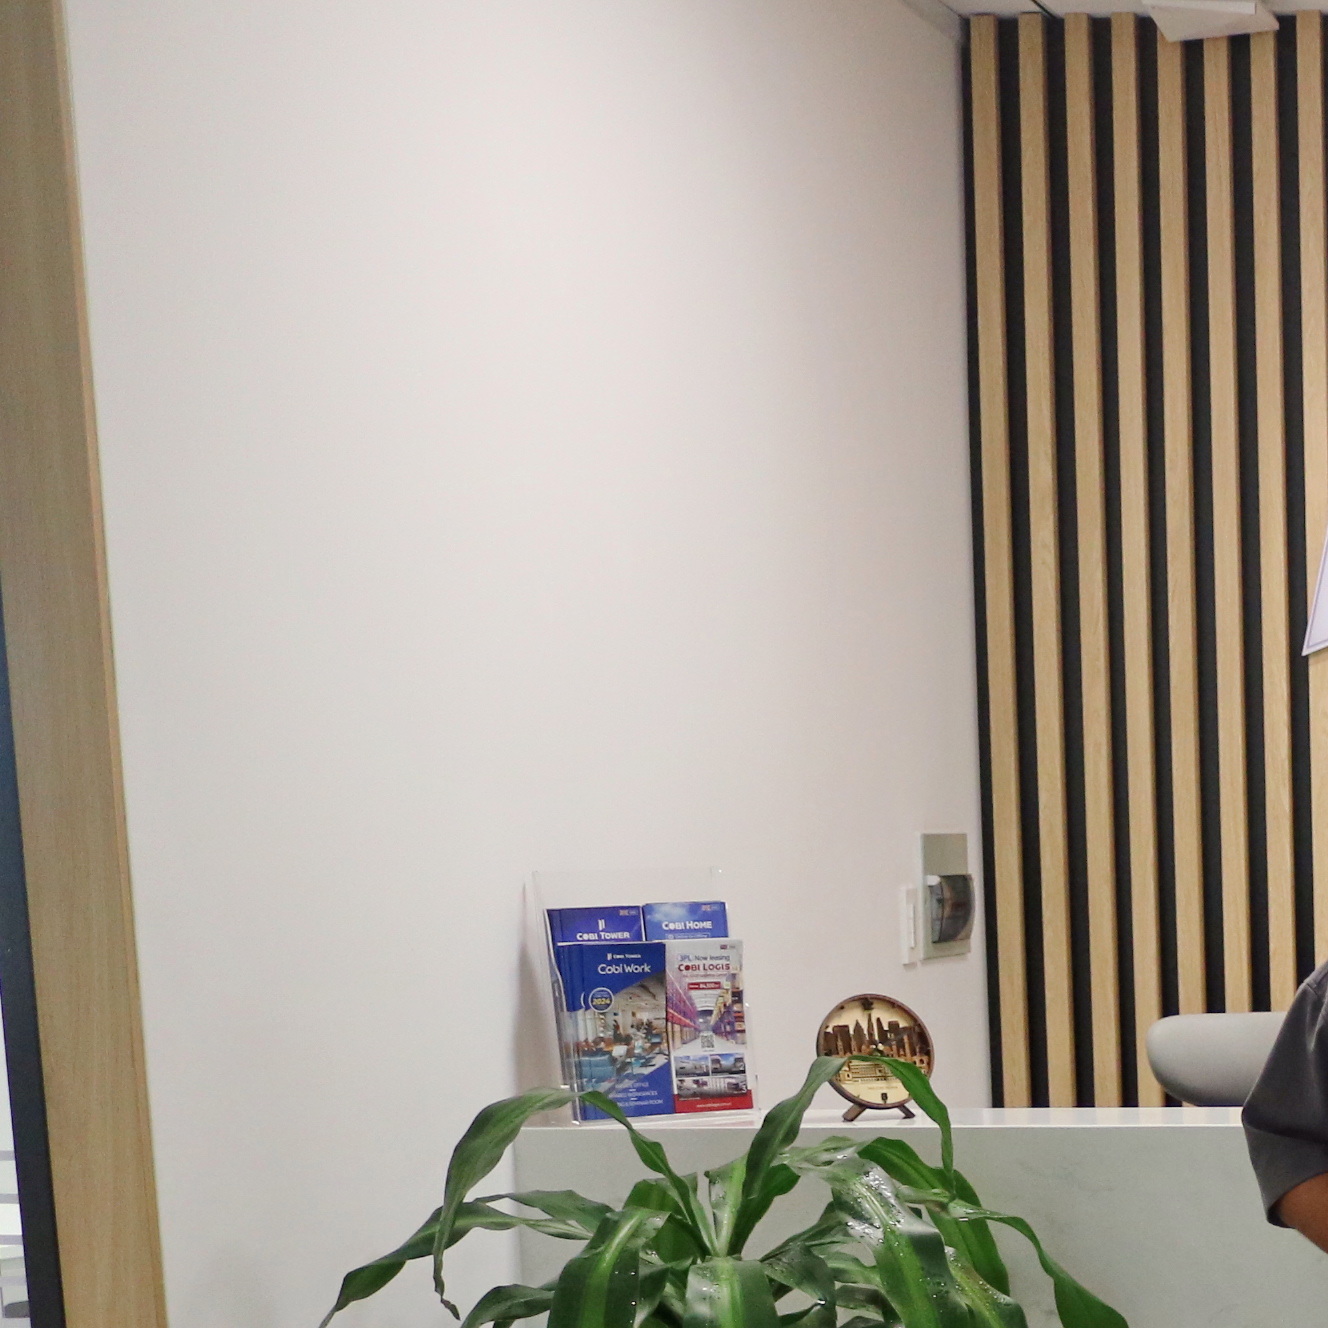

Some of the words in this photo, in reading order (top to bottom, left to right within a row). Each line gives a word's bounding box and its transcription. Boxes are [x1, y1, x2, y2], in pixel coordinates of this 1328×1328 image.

[662, 921, 685, 930] COBI
[686, 921, 713, 930] HOME
[600, 931, 631, 940] TOWER
[624, 963, 651, 973] Work
[702, 963, 730, 971] LOGIS
